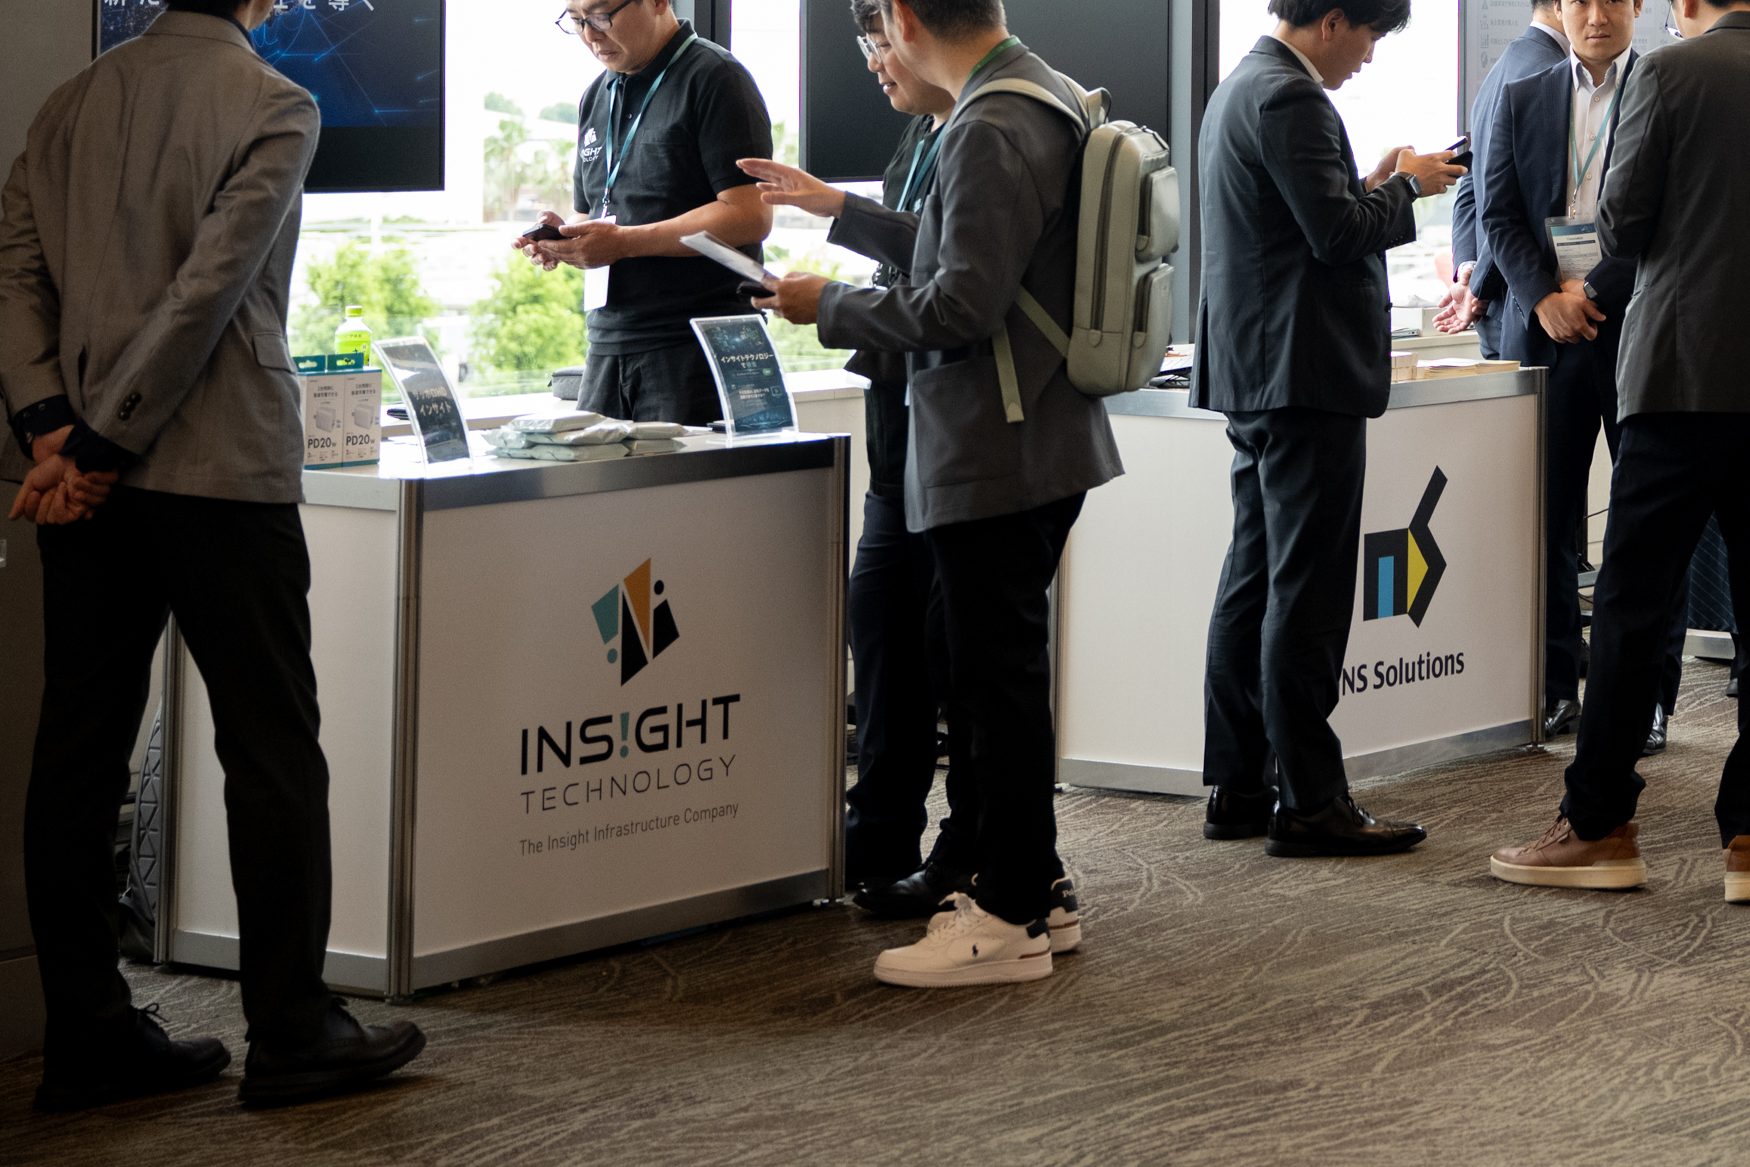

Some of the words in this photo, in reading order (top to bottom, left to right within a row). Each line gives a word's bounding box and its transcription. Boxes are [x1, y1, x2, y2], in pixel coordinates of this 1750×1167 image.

[721, 353, 774, 363] インサイトテクノロジー
[1341, 664, 1368, 696] NS
[1373, 651, 1465, 689] Solutions
[520, 693, 741, 776] INS!GHT
[520, 754, 737, 815] TECHNOLOGY
[520, 838, 543, 856] The
[548, 829, 590, 851] Insight
[594, 814, 681, 842] Infrastructure
[684, 803, 740, 824] Company
